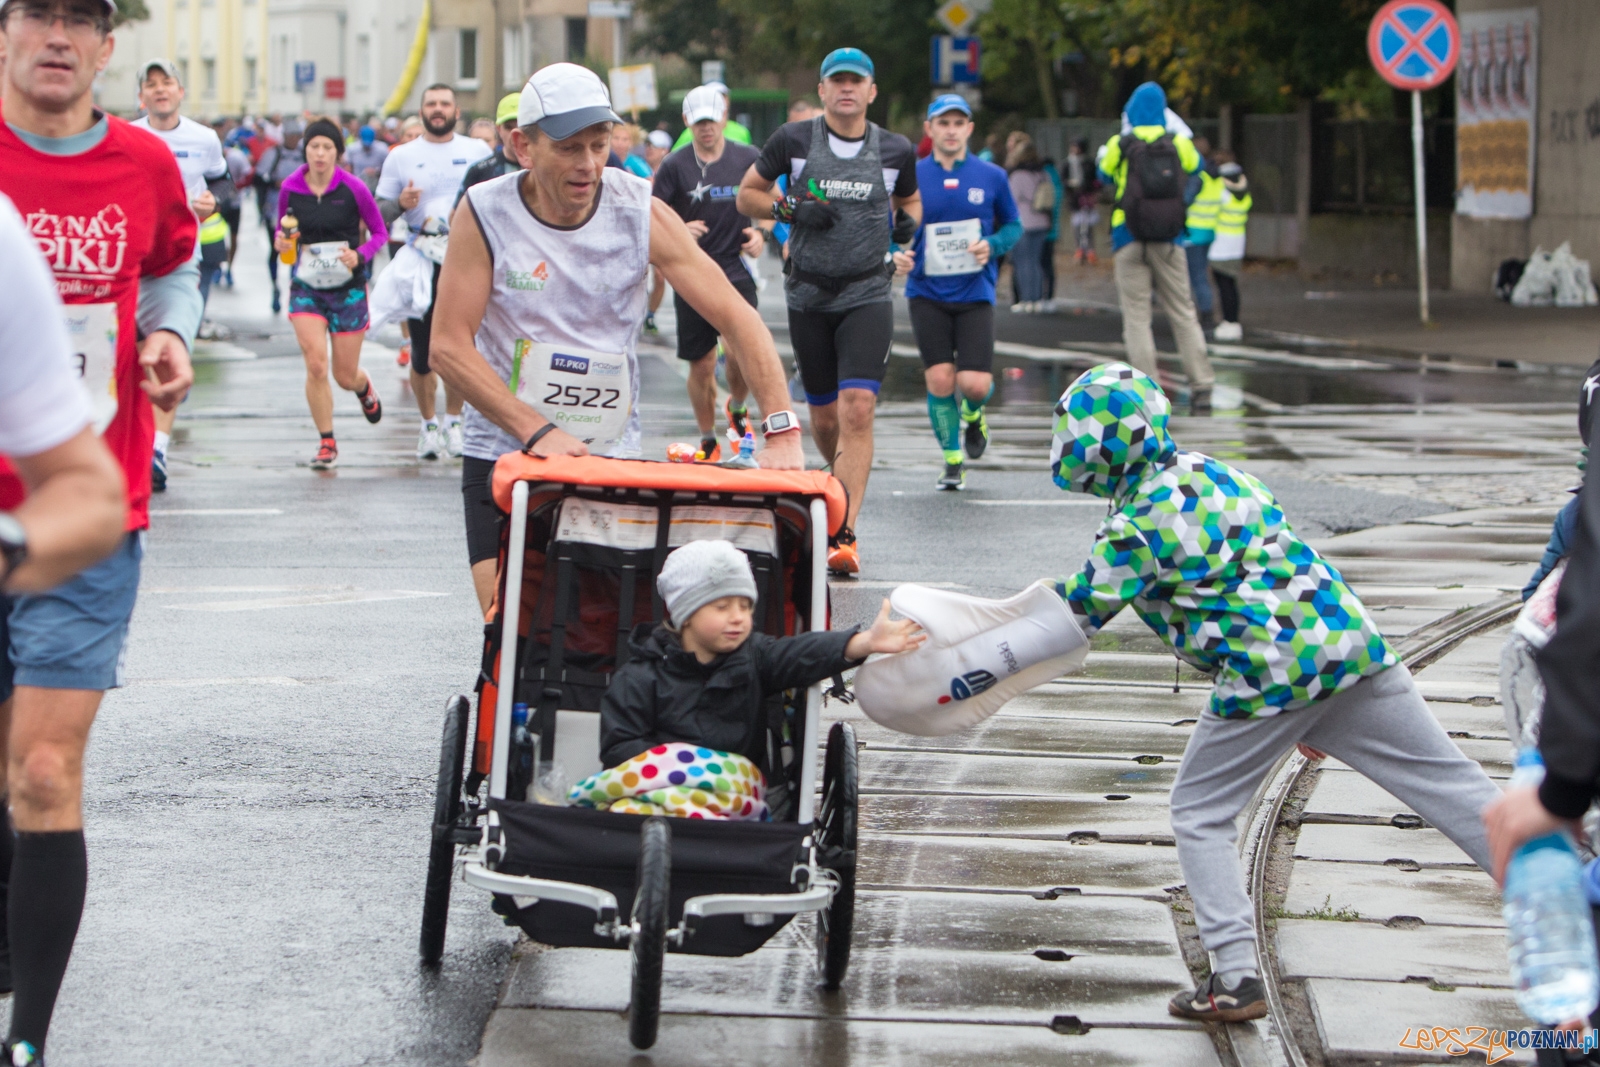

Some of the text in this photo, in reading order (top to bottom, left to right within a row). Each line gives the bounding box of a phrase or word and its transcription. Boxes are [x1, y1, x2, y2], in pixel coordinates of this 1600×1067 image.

[819, 180, 873, 193] LUBELSKI
[826, 189, 870, 200] BIEGACZ
[506, 280, 546, 291] FAMILY
[543, 382, 620, 409] 2522
[556, 411, 602, 423] Ryszard
